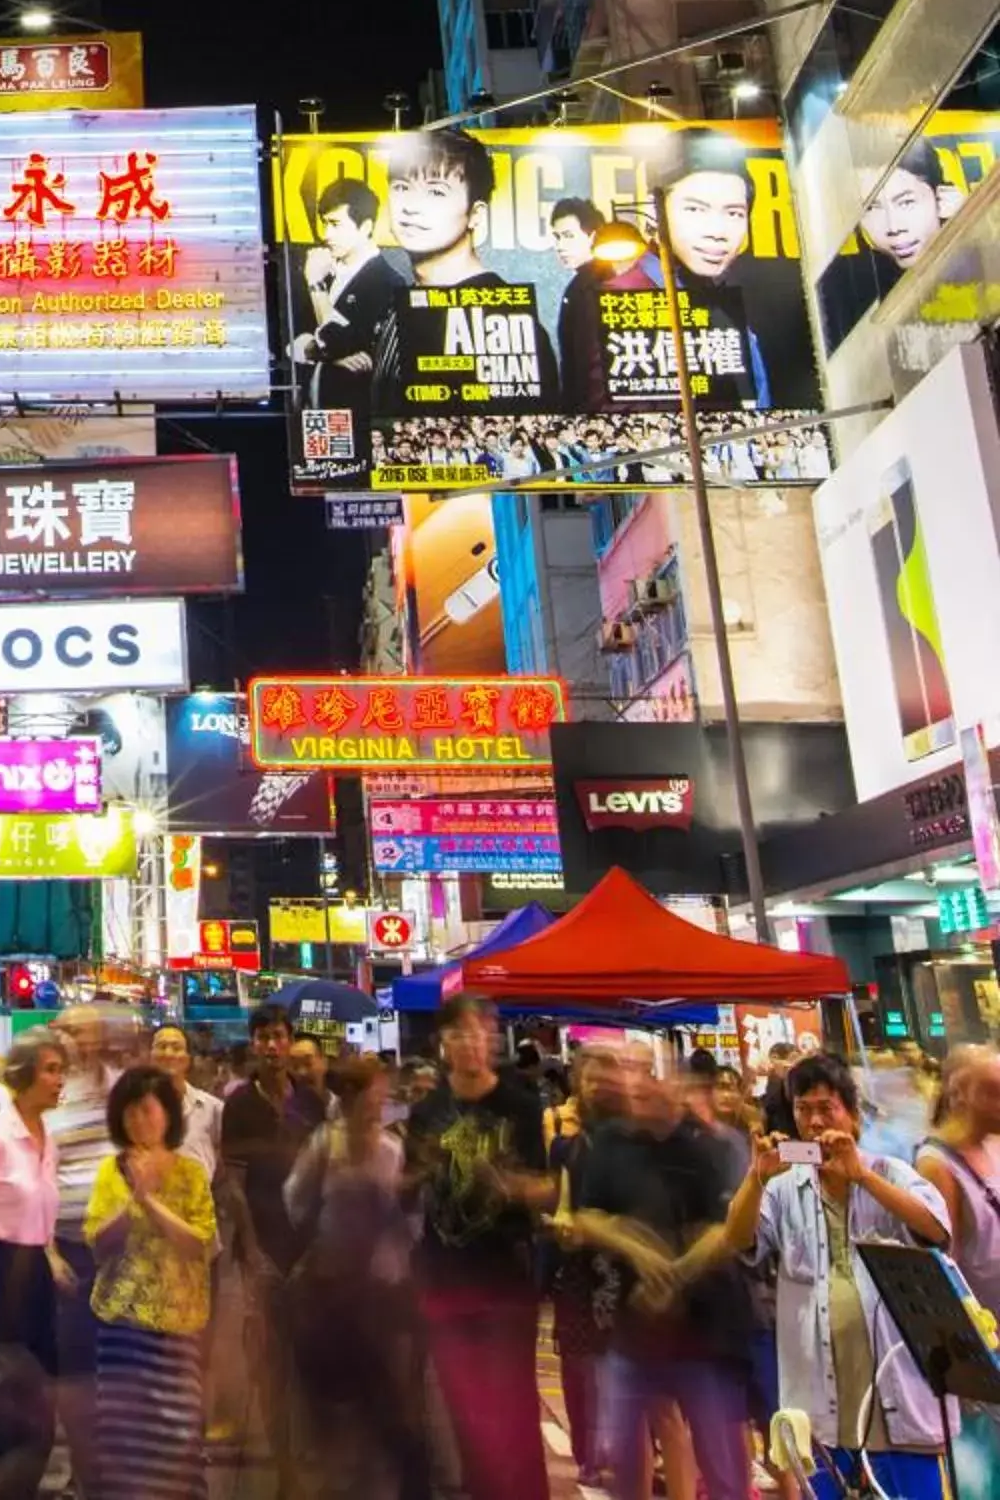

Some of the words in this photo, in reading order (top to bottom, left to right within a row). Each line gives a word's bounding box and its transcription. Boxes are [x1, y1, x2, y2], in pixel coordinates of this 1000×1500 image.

[20, 80, 46, 90] PAK
[50, 77, 96, 90] LEUNG
[1, 151, 172, 227] 永成
[32, 288, 147, 313] Authorized
[156, 287, 225, 310] Dealer
[443, 306, 537, 355] Alan
[476, 355, 541, 383] CHAN
[262, 685, 557, 734] 維珍尼亞賓館
[291, 736, 414, 760] VIRGINIA
[434, 736, 531, 760] HOTEL
